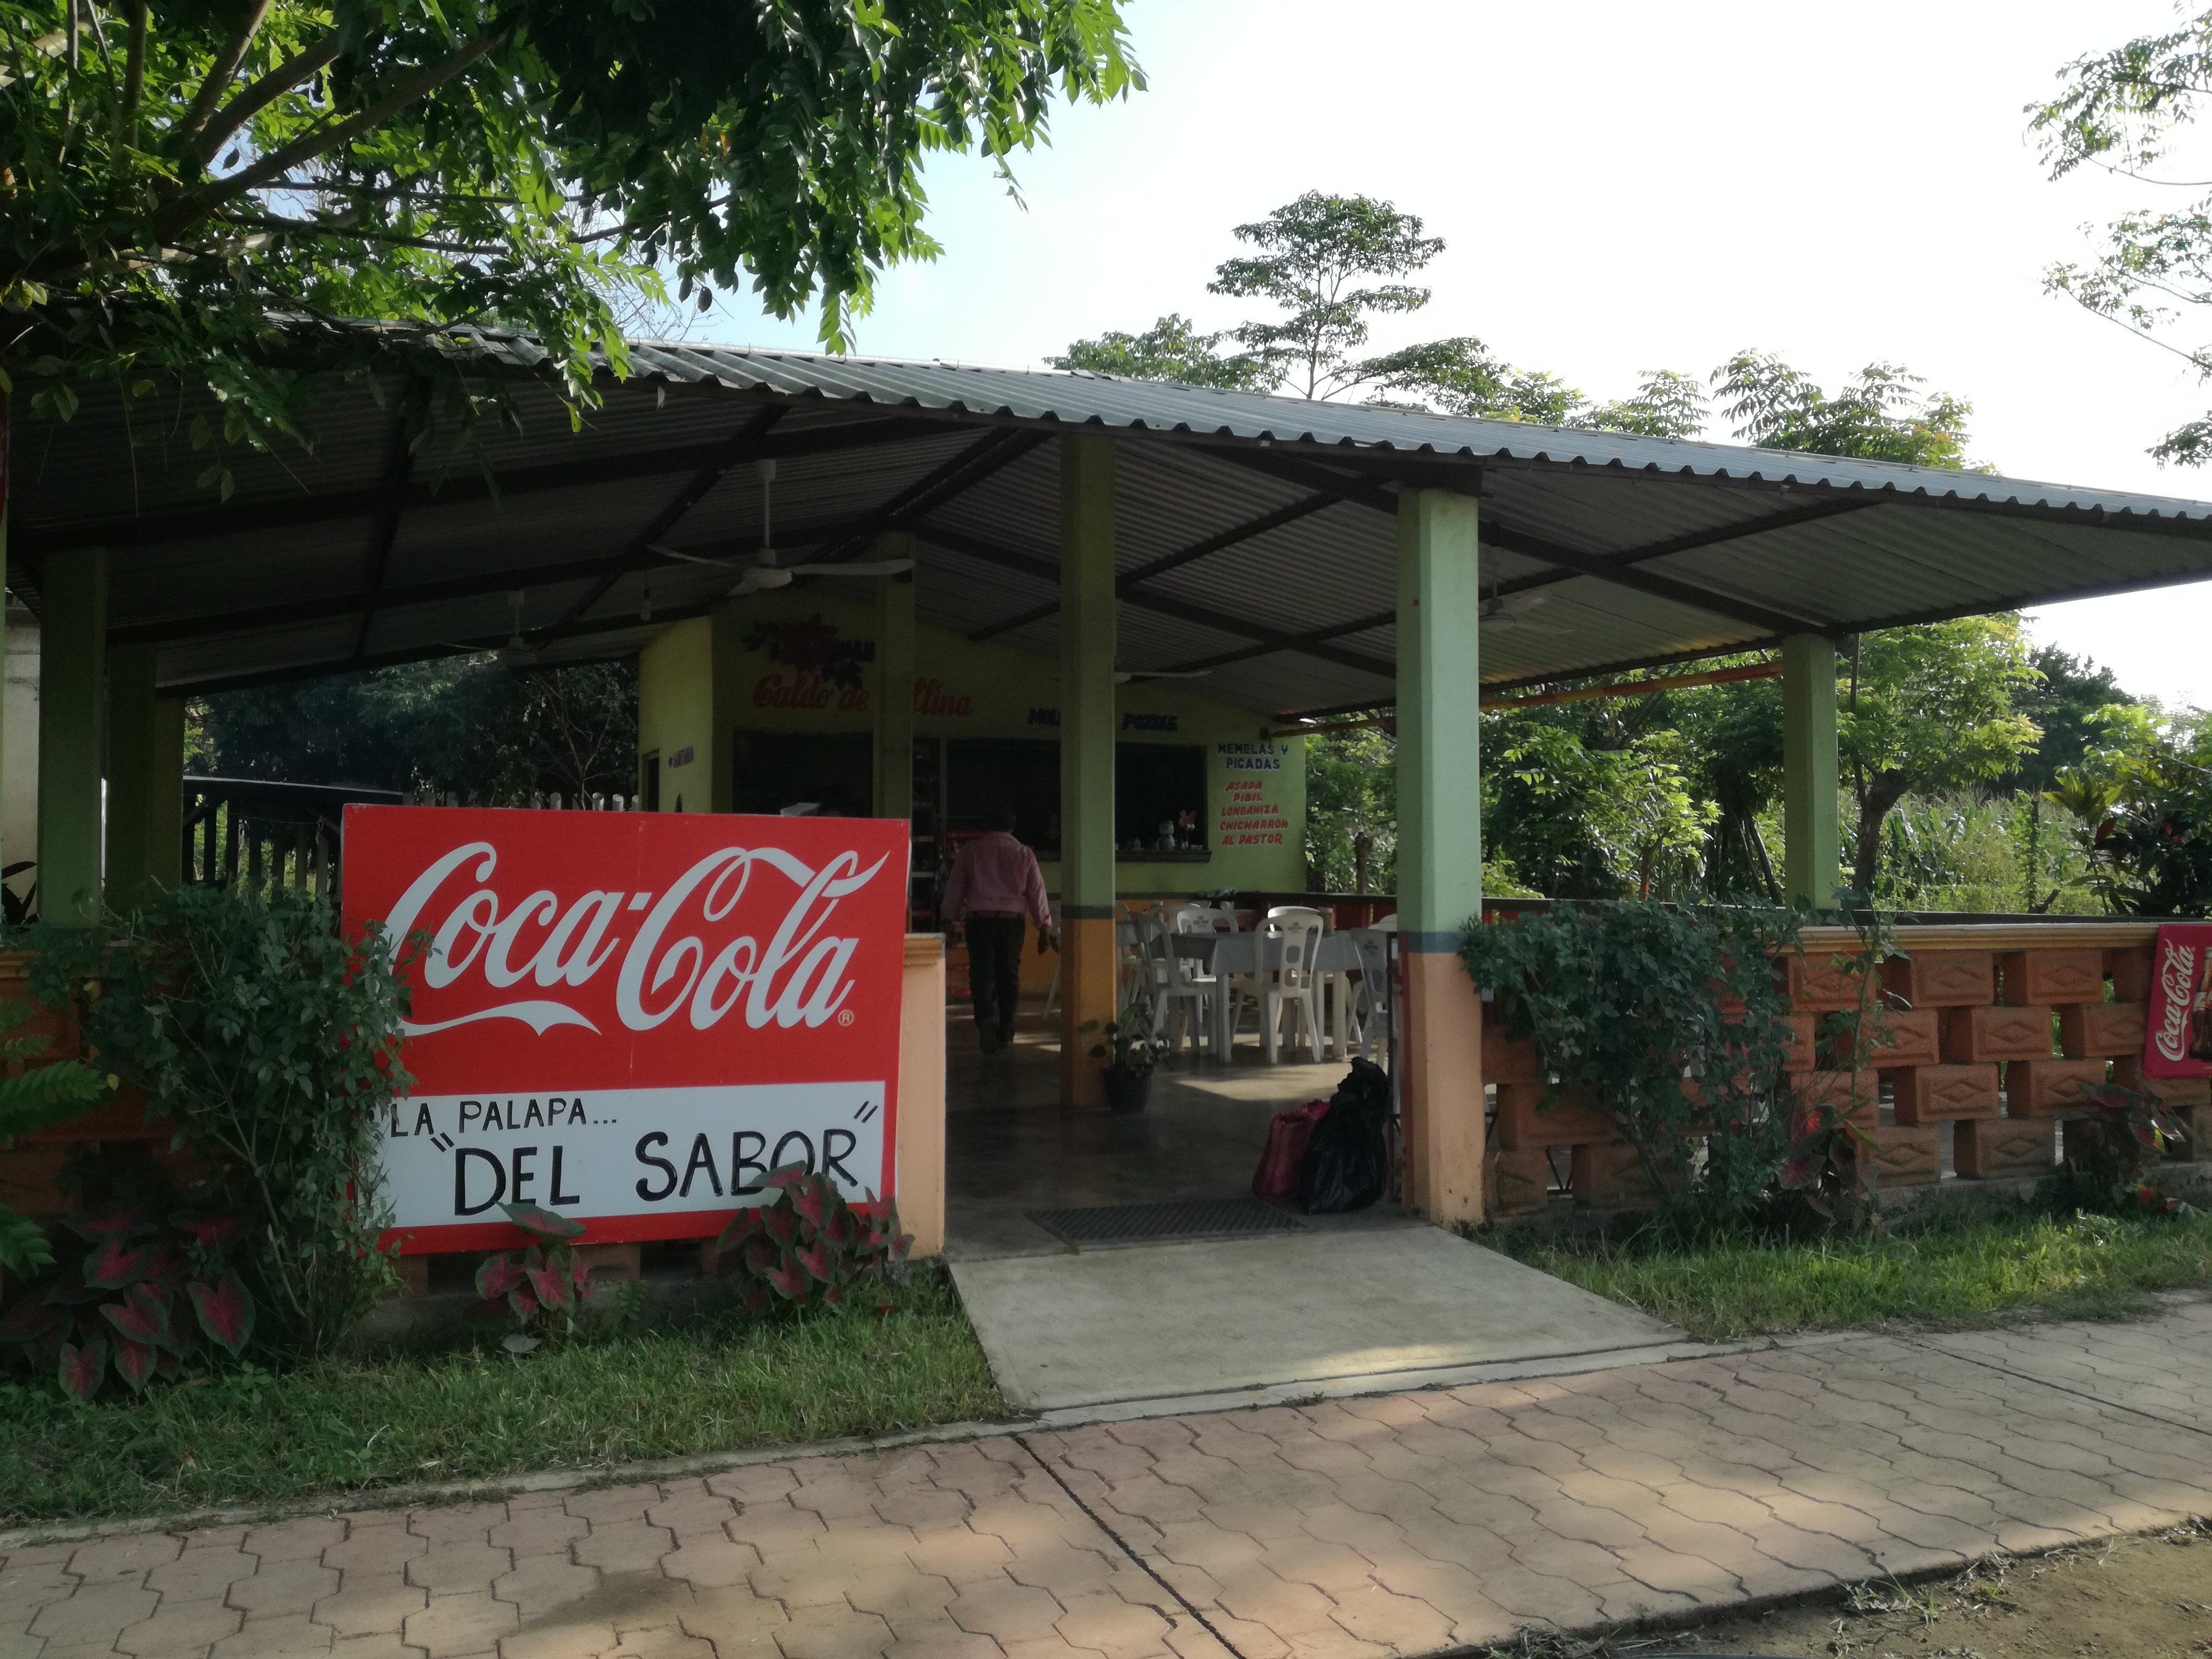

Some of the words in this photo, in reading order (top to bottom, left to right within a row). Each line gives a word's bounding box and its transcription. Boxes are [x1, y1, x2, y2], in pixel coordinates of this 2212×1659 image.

[752, 674, 834, 709] Caldo
[913, 676, 973, 717] llina
[1218, 743, 1274, 755] MEMELAS
[1281, 745, 1288, 755] Y
[1226, 758, 1280, 769] PICADAS
[1225, 781, 1263, 791] ASADA
[1233, 793, 1263, 802] PIBIL
[1220, 805, 1278, 817] LONGANIZA
[1219, 819, 1288, 831] CHICHARRON
[1221, 835, 1234, 845] AL
[1238, 833, 1283, 845] PASTOR
[384, 842, 890, 1036] Coca-Cola
[2156, 939, 2194, 1062] Coca-Cola
[391, 1103, 434, 1137] LA
